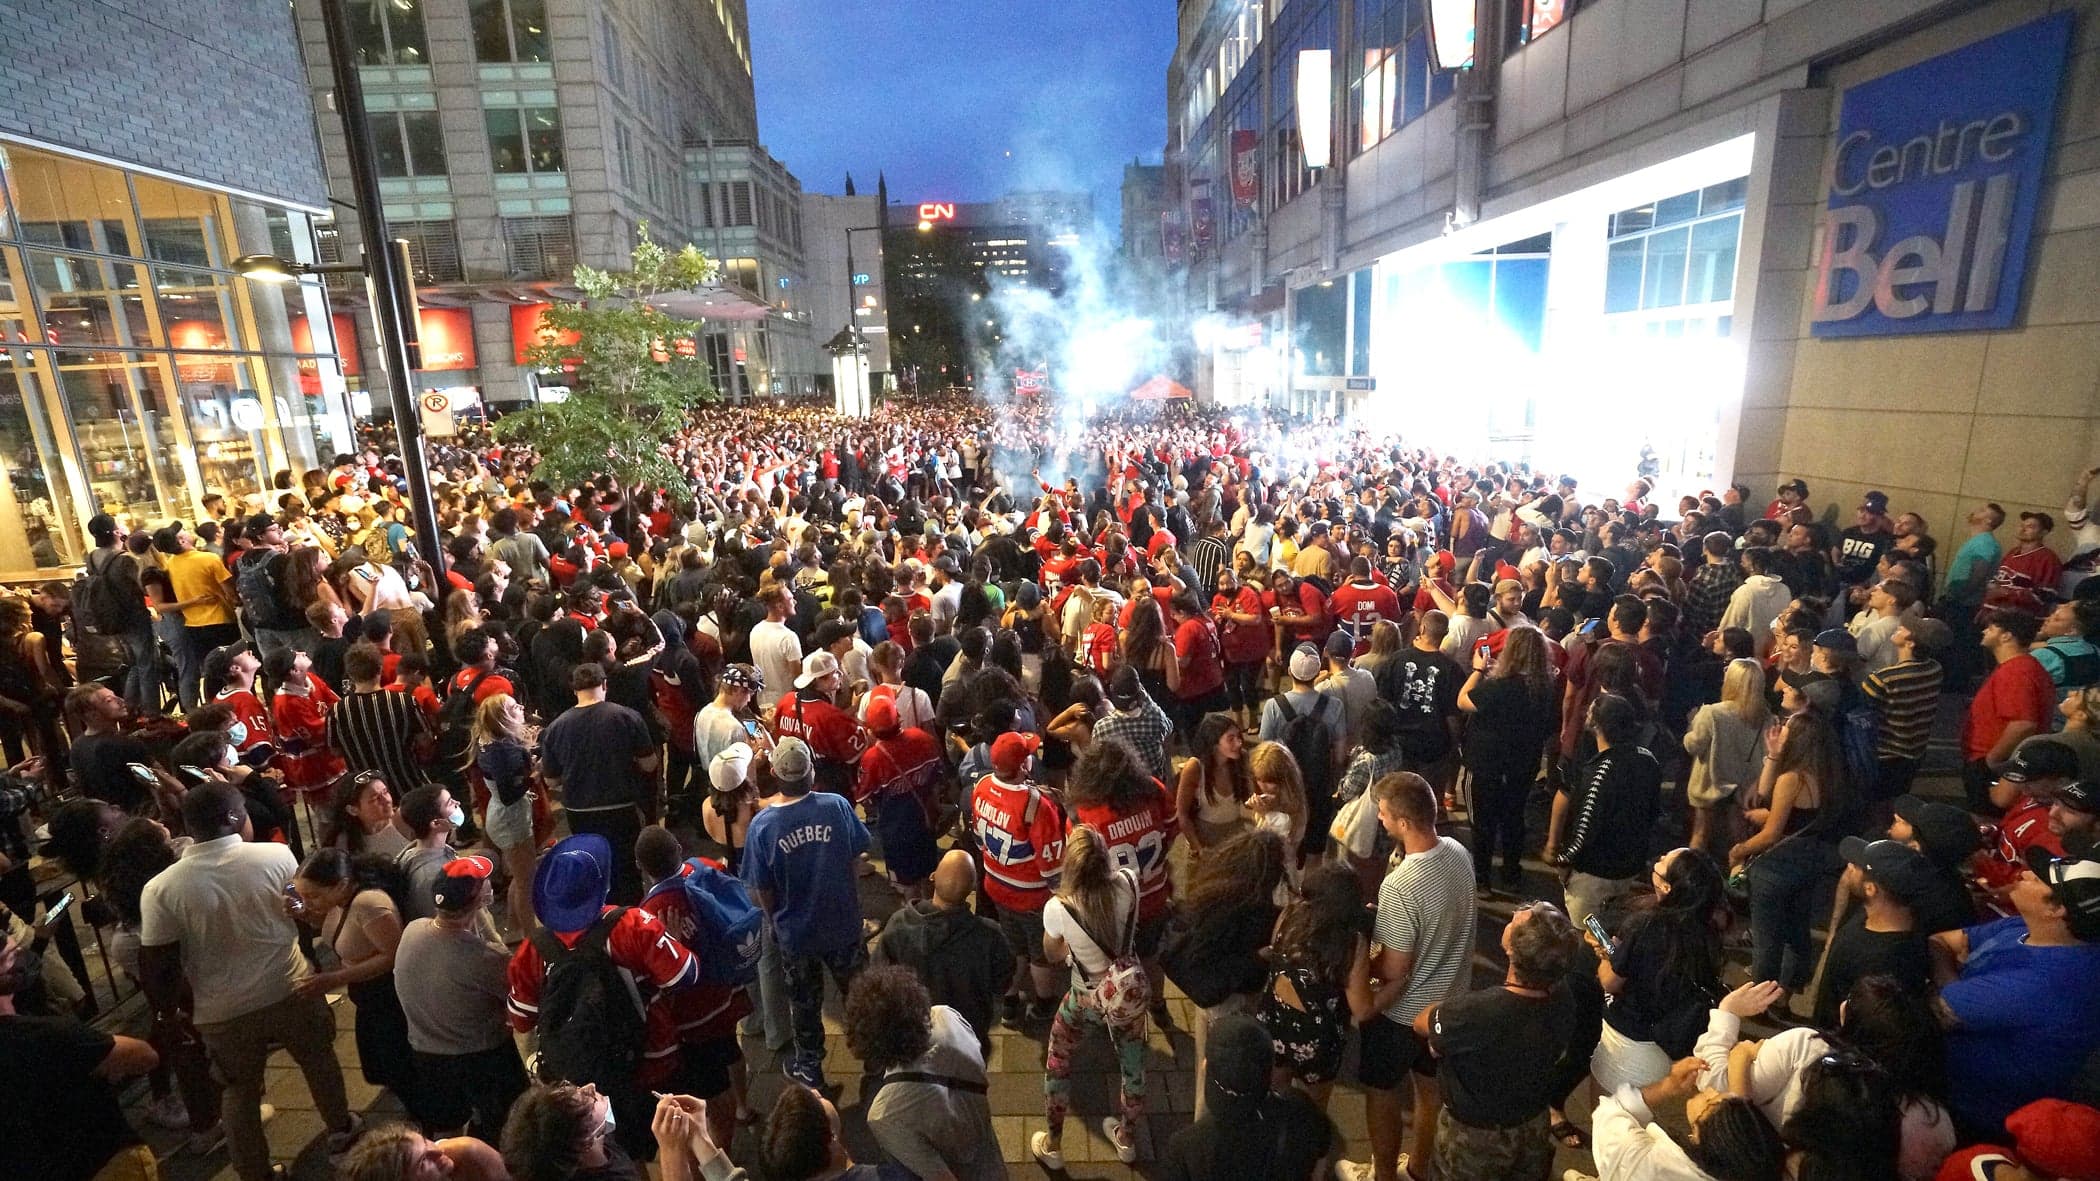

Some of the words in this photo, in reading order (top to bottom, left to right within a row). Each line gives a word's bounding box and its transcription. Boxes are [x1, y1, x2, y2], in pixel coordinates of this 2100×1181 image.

[1832, 112, 2020, 196] Centre
[920, 203, 954, 219] CN
[1812, 174, 2009, 321] Bell
[1843, 538, 1875, 559] BIG
[1357, 600, 1375, 612] DOMI
[249, 715, 267, 732] 15
[780, 715, 812, 740] KOVAEV
[1107, 810, 1153, 841] DROUIN
[778, 824, 833, 855] QUEBEC
[1042, 840, 1063, 863] 47
